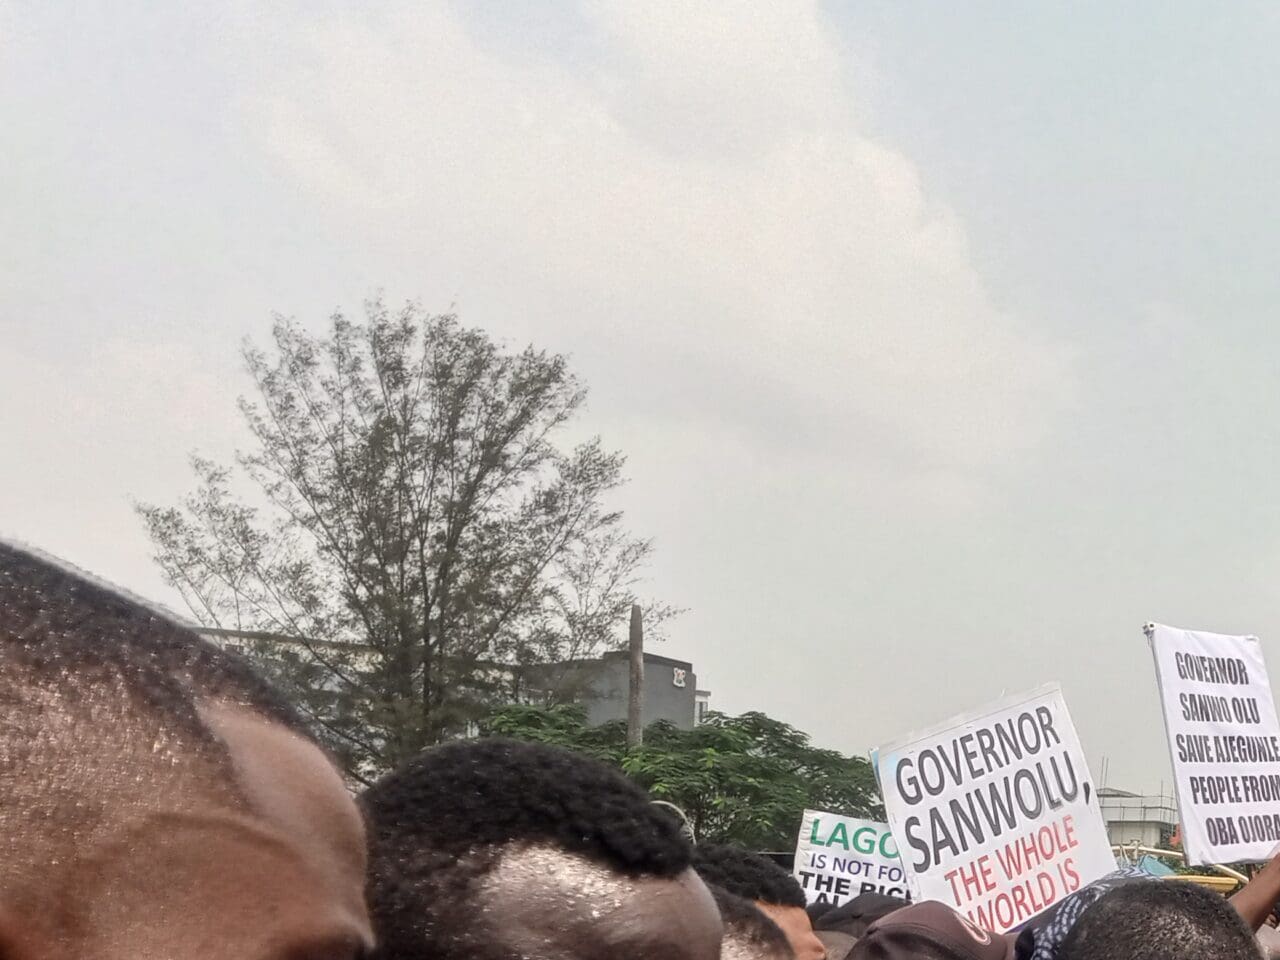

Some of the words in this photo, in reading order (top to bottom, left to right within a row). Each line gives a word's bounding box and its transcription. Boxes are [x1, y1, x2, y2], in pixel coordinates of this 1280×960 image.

[1175, 652, 1249, 685] GOVERNOR
[1179, 692, 1232, 723] SANWO
[1231, 697, 1260, 724] OLU
[896, 706, 1060, 805] GOVERNOR
[1176, 733, 1213, 763] SAVE
[1190, 776, 1242, 804] PEOPLE
[905, 750, 1091, 873] SANWOLU,
[1206, 817, 1239, 846] OBA
[811, 853, 827, 869] IS
[832, 857, 874, 877] NOT
[878, 865, 907, 883] FO
[944, 855, 996, 907] THE
[995, 815, 1078, 880] WHOLE
[799, 871, 851, 895] THE
[968, 872, 1056, 932] WORLD
[1057, 858, 1080, 895] IS
